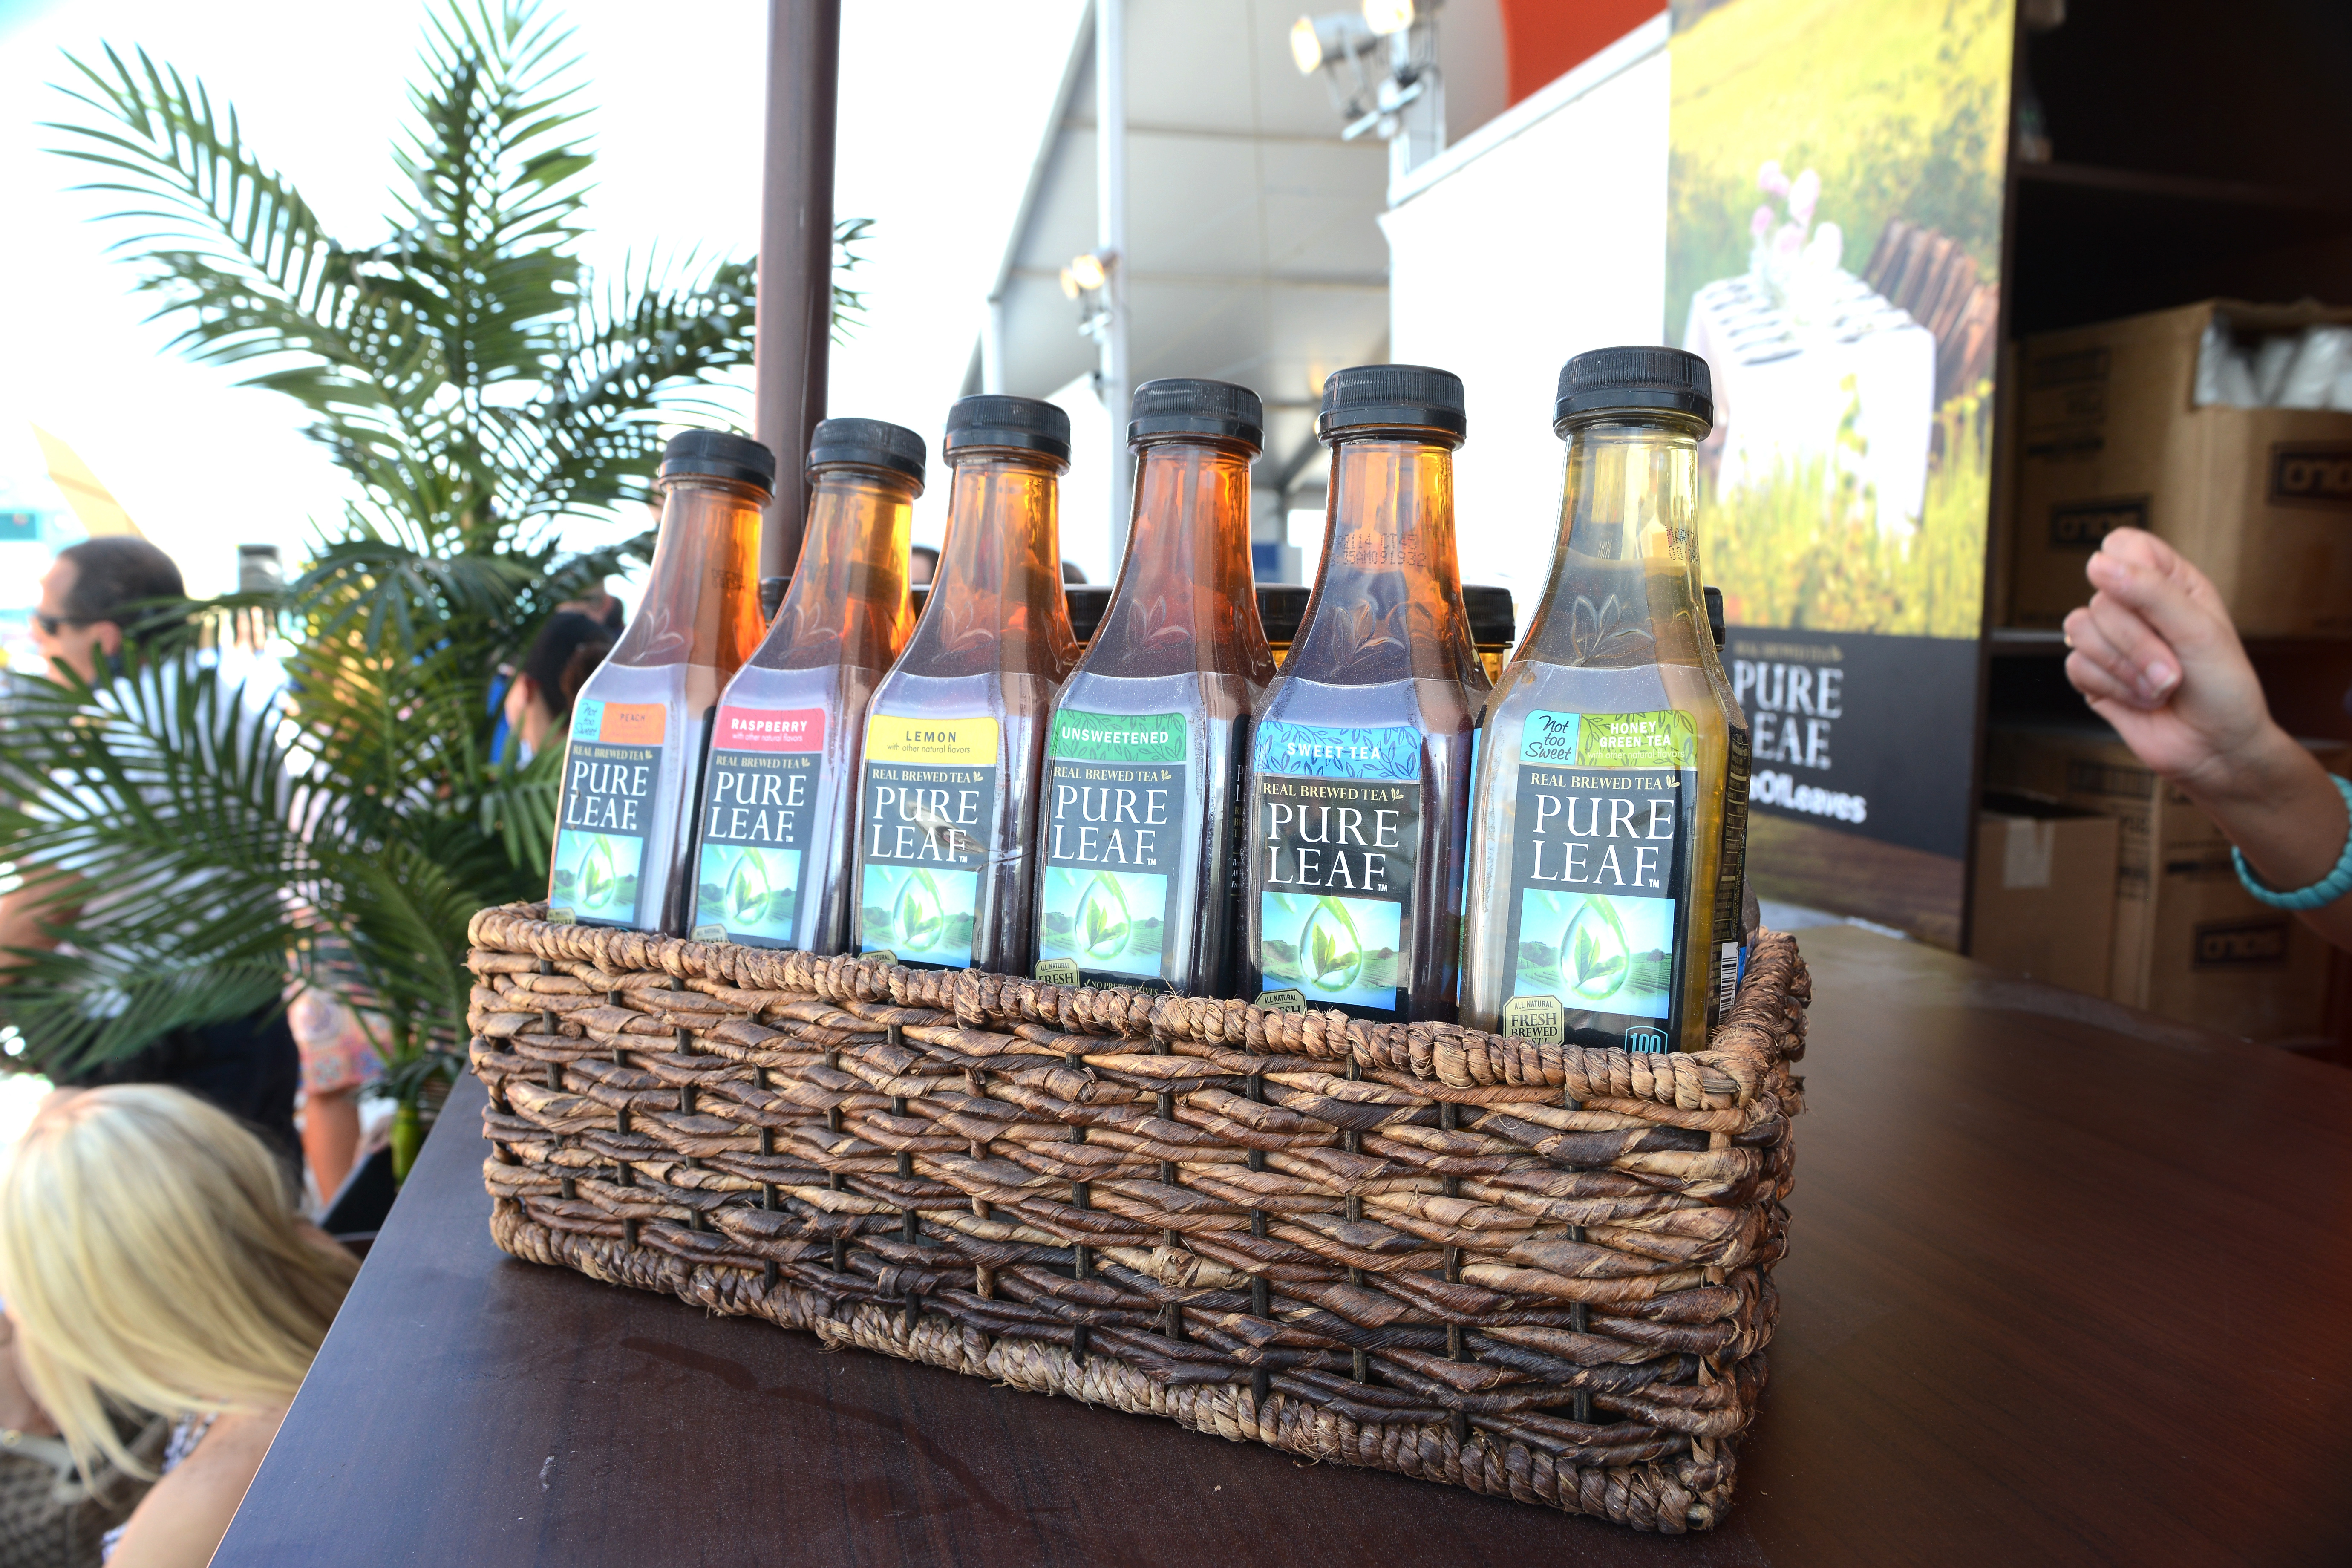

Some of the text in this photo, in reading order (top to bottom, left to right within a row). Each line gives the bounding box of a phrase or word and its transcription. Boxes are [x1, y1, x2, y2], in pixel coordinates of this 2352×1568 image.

[1732, 660, 1844, 719] PURE
[731, 718, 807, 732] RASPBERRY
[1539, 715, 1569, 734] Not
[1611, 721, 1657, 734] HONEY
[746, 733, 760, 741] other
[783, 734, 802, 742] flavors
[906, 730, 956, 743] LEMON
[1062, 726, 1169, 744] UNSWEETENED
[1544, 733, 1565, 747] too
[1599, 735, 1671, 748] GREEN TEA
[1751, 711, 1831, 767] EAF
[573, 745, 643, 761] REAL BREWED TEA
[887, 742, 970, 753] with other natural flavors
[1287, 742, 1381, 760] SWEET TEA
[1525, 742, 1572, 760] Sweet
[1588, 749, 1685, 759] with other natural flavors
[716, 755, 799, 769] REAL BREWED TEA
[571, 760, 649, 796] PURE
[872, 769, 971, 783] REAL BREWED TEA
[1054, 766, 1158, 782] REAL BREWED TEA
[1531, 773, 1663, 790] REAL BREWED TEA
[713, 771, 806, 806] PURE
[1263, 783, 1388, 801] REAL BREWED TEA
[565, 794, 638, 830] LEAF
[873, 786, 979, 824] PURE
[1054, 785, 1167, 824] PURE
[708, 807, 795, 842] LEAF
[1268, 803, 1399, 848] PURE
[1533, 794, 1674, 840] PURE
[870, 824, 966, 862] LEAF
[1052, 824, 1156, 865] LEAF
[1268, 846, 1386, 891] LEAF
[1530, 839, 1659, 887] LEAF
[1264, 996, 1273, 1004] ALL
[1514, 1002, 1525, 1010] ALL
[1511, 1013, 1556, 1027] FRESH
[1511, 1026, 1558, 1037] BREWED
[1630, 1032, 1661, 1054] 100
